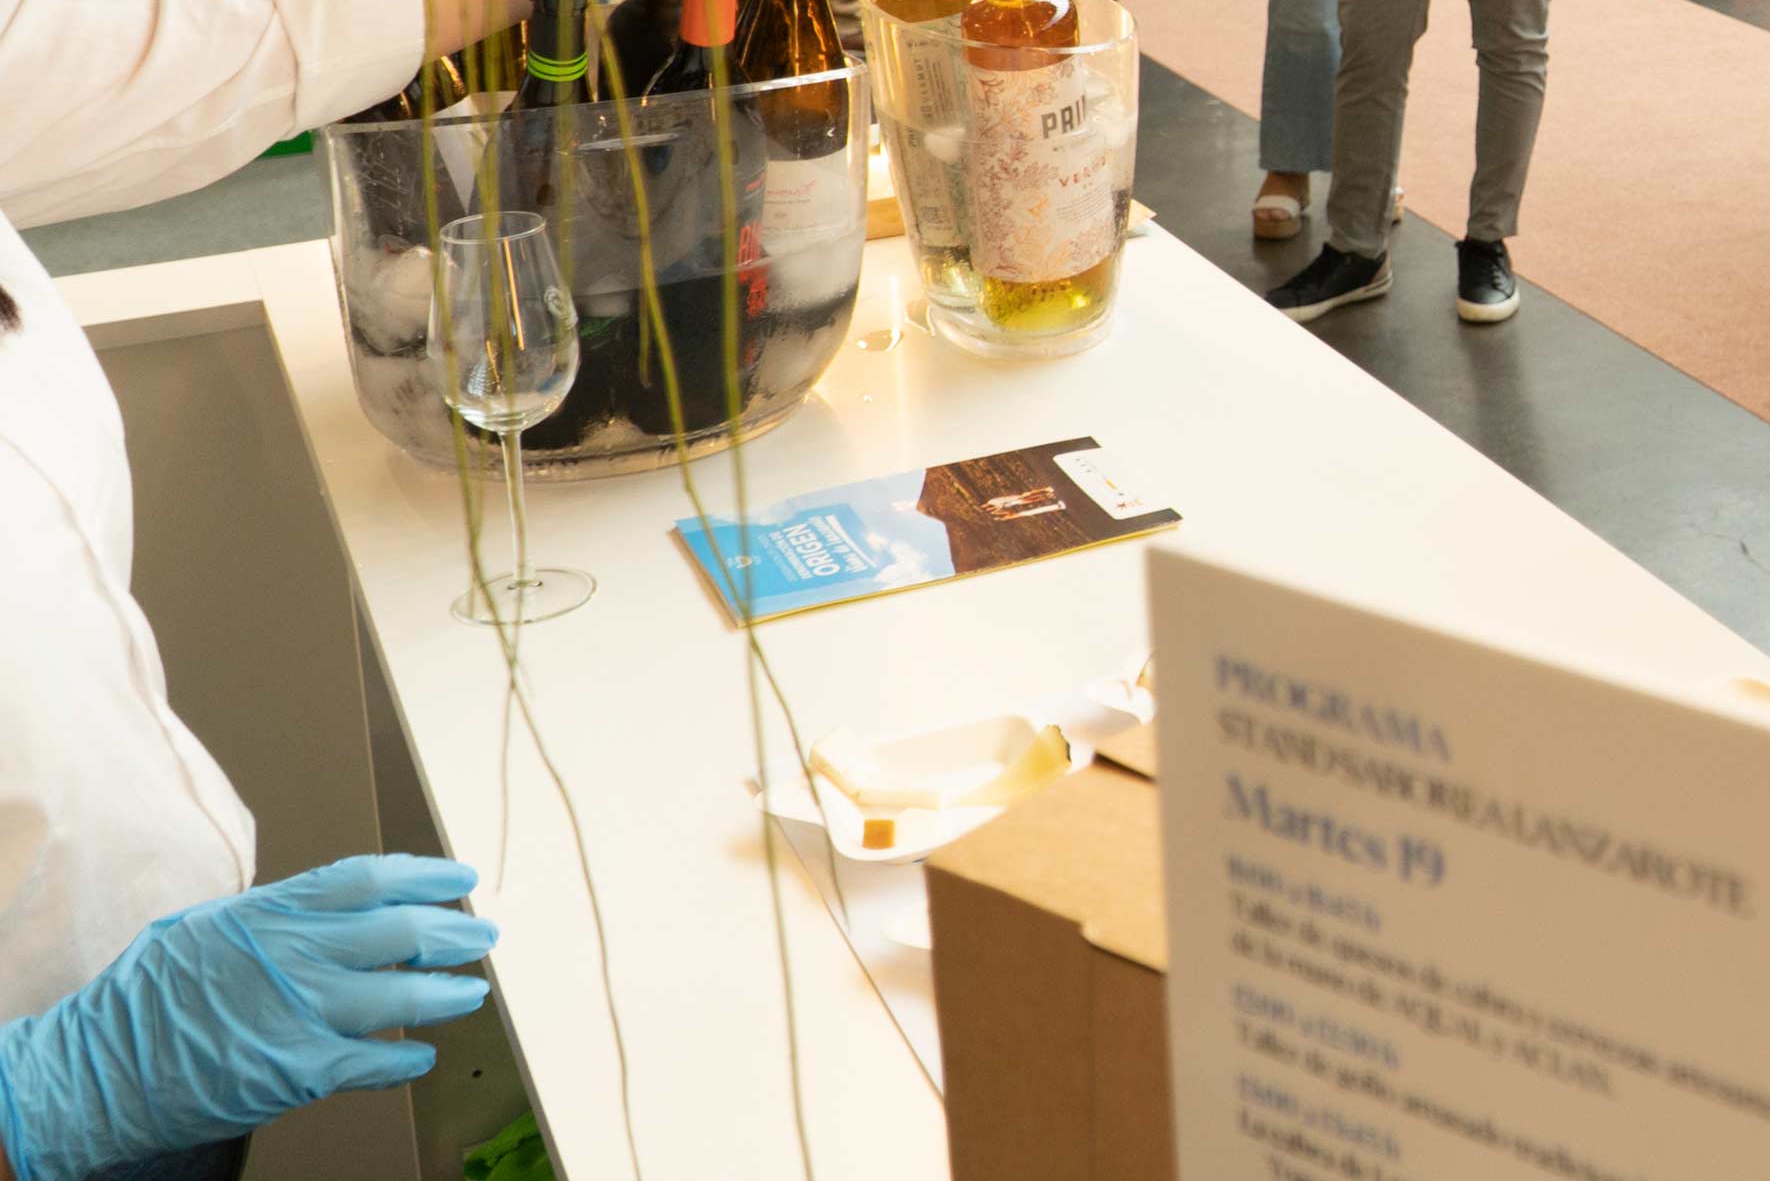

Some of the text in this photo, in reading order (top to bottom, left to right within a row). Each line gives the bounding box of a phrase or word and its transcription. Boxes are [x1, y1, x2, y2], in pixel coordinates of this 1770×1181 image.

[783, 522, 840, 576] ORIGEN
[1215, 653, 1452, 764] PROGRAMA
[1223, 774, 1447, 891] Martes 19
[1511, 803, 1757, 917] LANZAROTE
